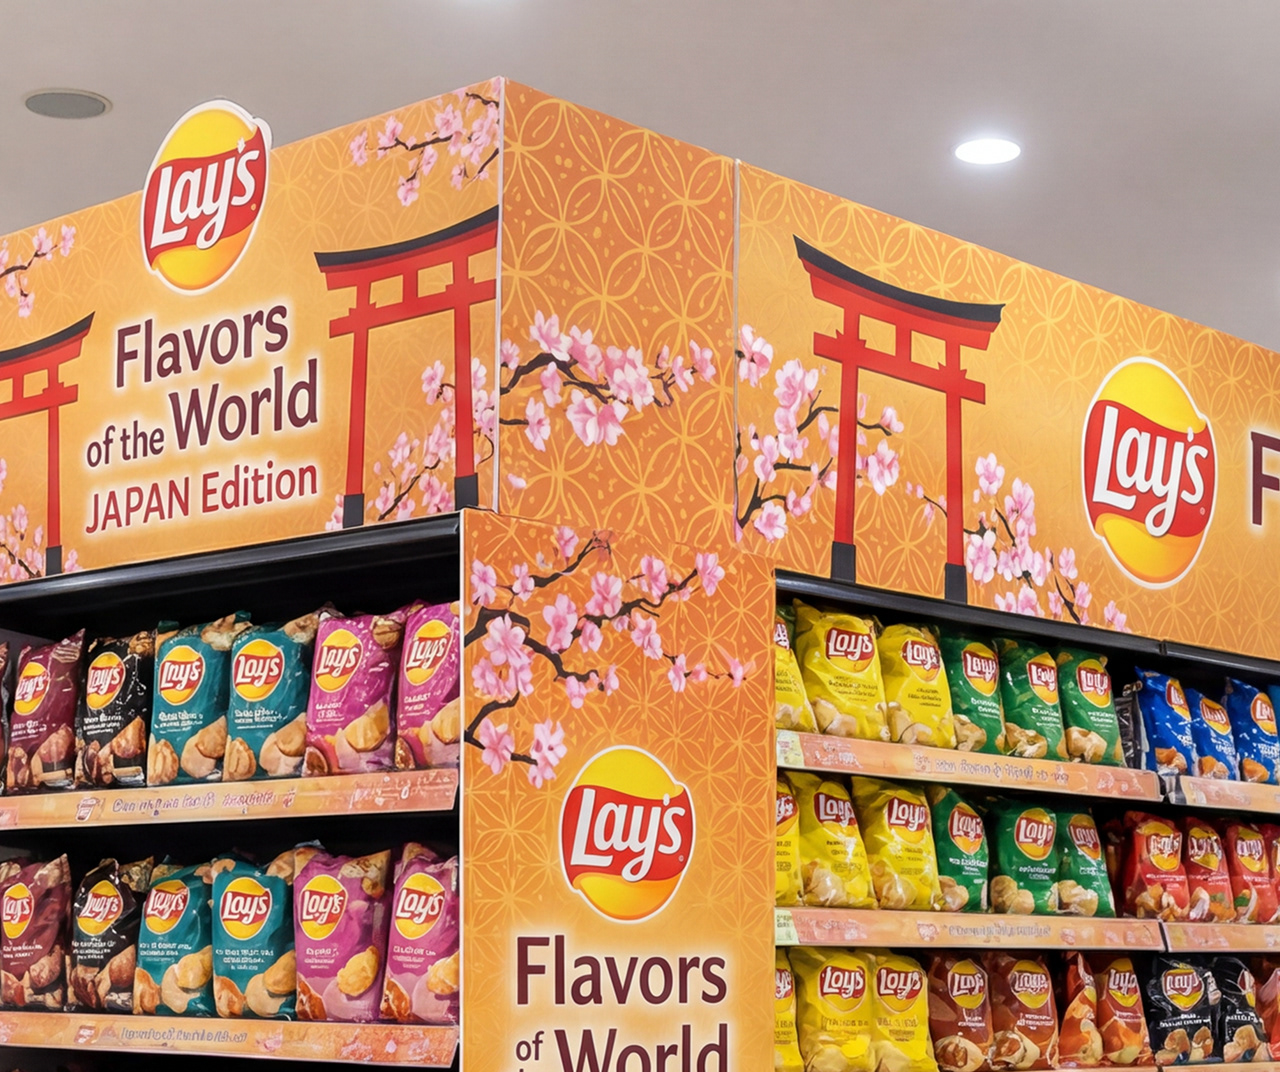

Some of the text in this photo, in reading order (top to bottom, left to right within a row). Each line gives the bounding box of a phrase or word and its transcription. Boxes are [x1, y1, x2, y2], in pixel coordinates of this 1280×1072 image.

[151, 139, 261, 250] Lay's
[116, 305, 288, 388] Flavors
[87, 359, 318, 468] of the World
[86, 465, 317, 533] JAPAN Edition
[1093, 405, 1209, 537] Lay's
[569, 788, 686, 882] Lay's
[517, 934, 727, 1006] Flavors
[516, 1030, 545, 1061] of
